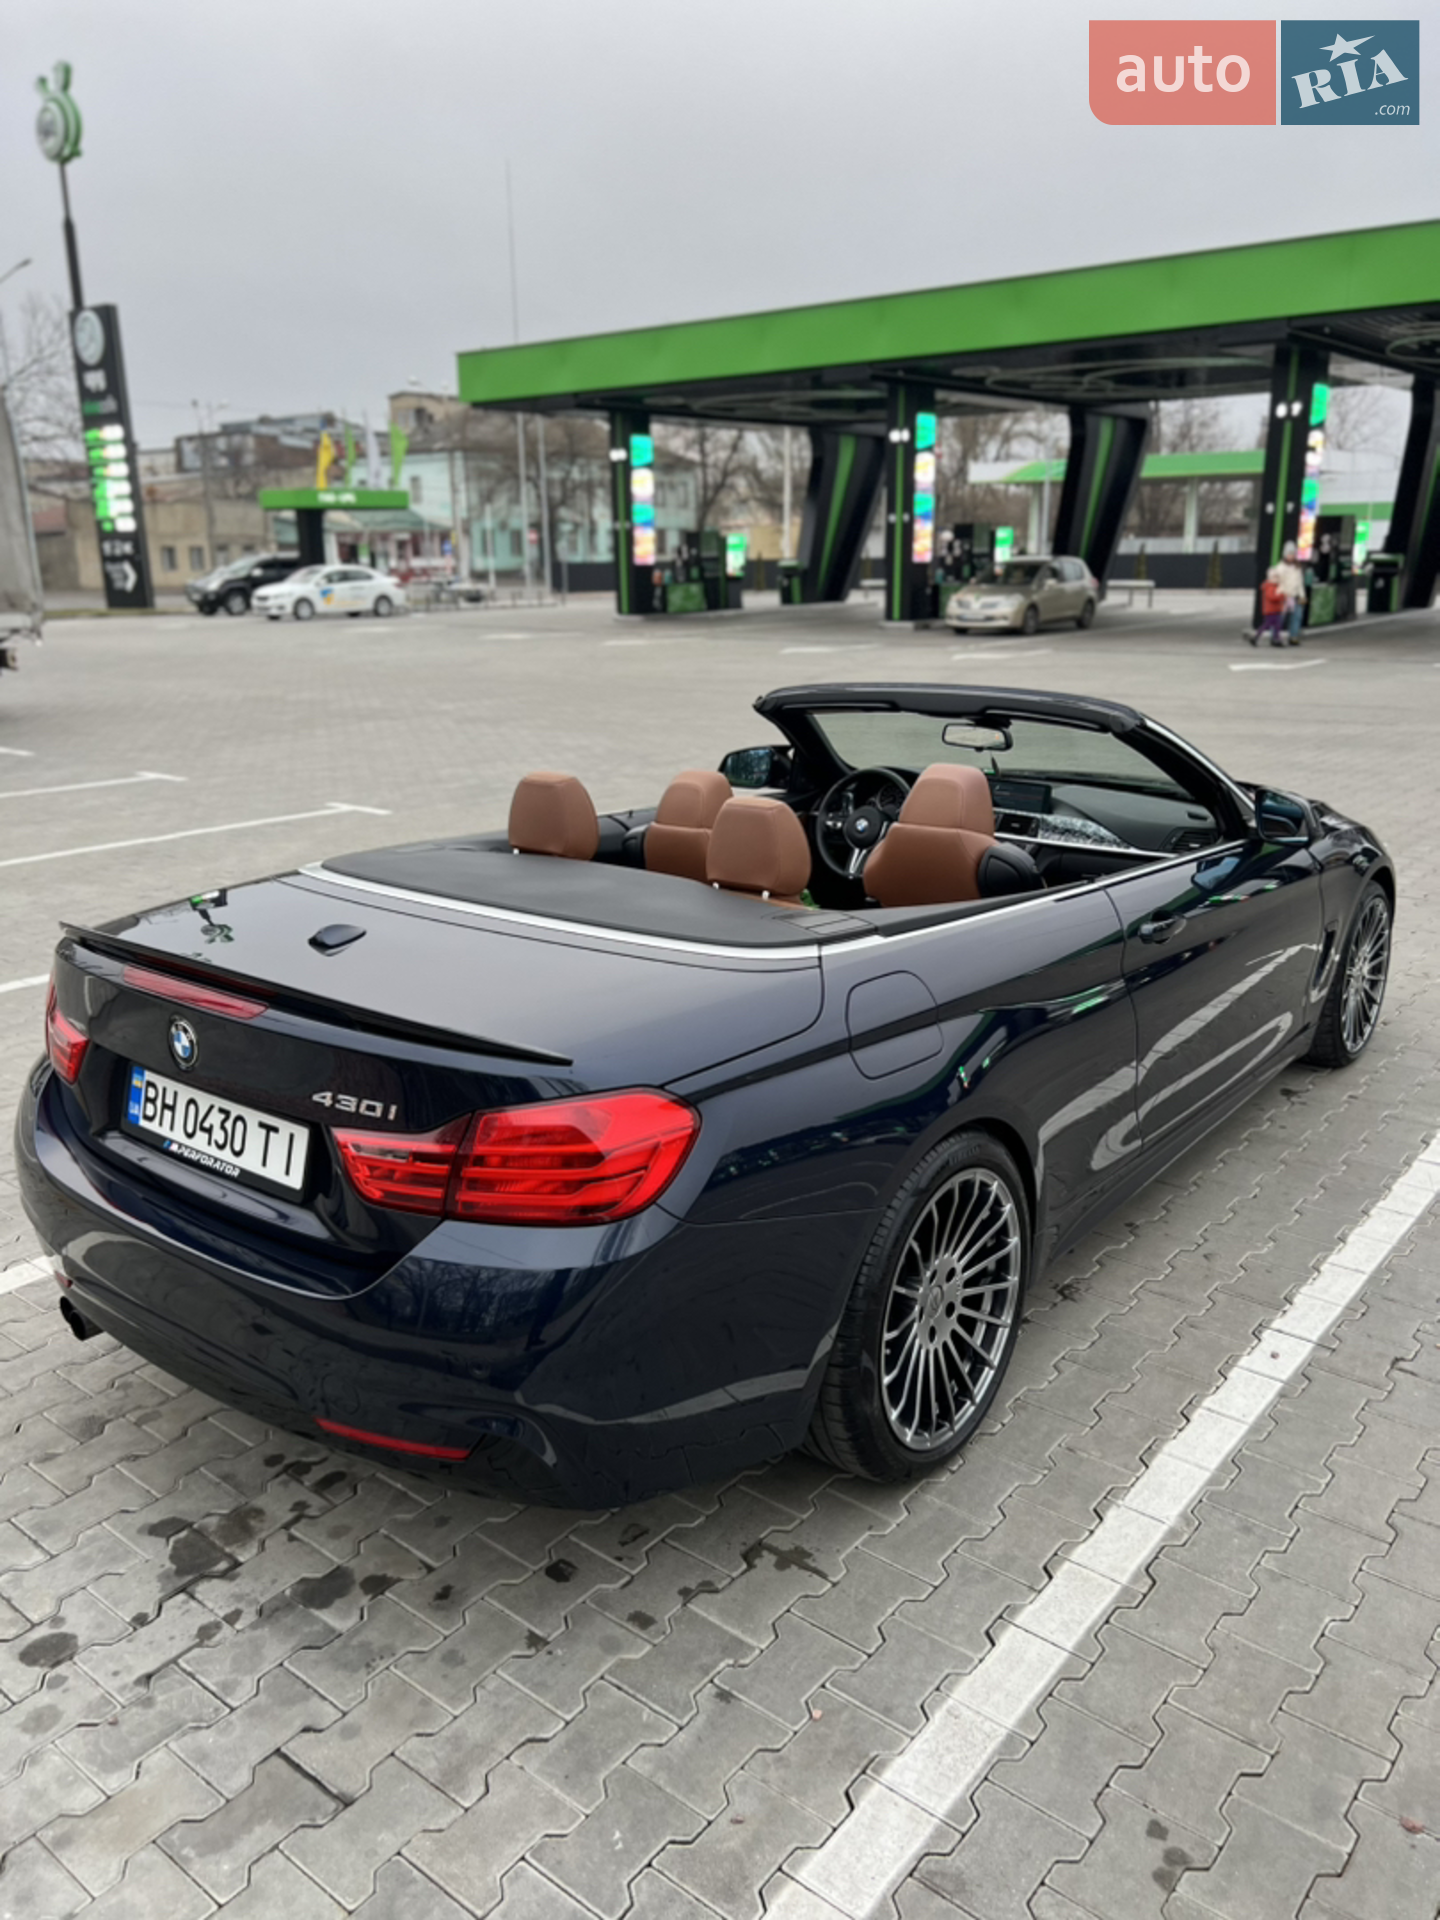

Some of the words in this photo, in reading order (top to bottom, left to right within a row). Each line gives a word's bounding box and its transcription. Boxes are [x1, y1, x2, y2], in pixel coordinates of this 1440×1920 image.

[141, 1080, 178, 1132] BH
[182, 1098, 248, 1158] 0430
[257, 1120, 295, 1177] TI
